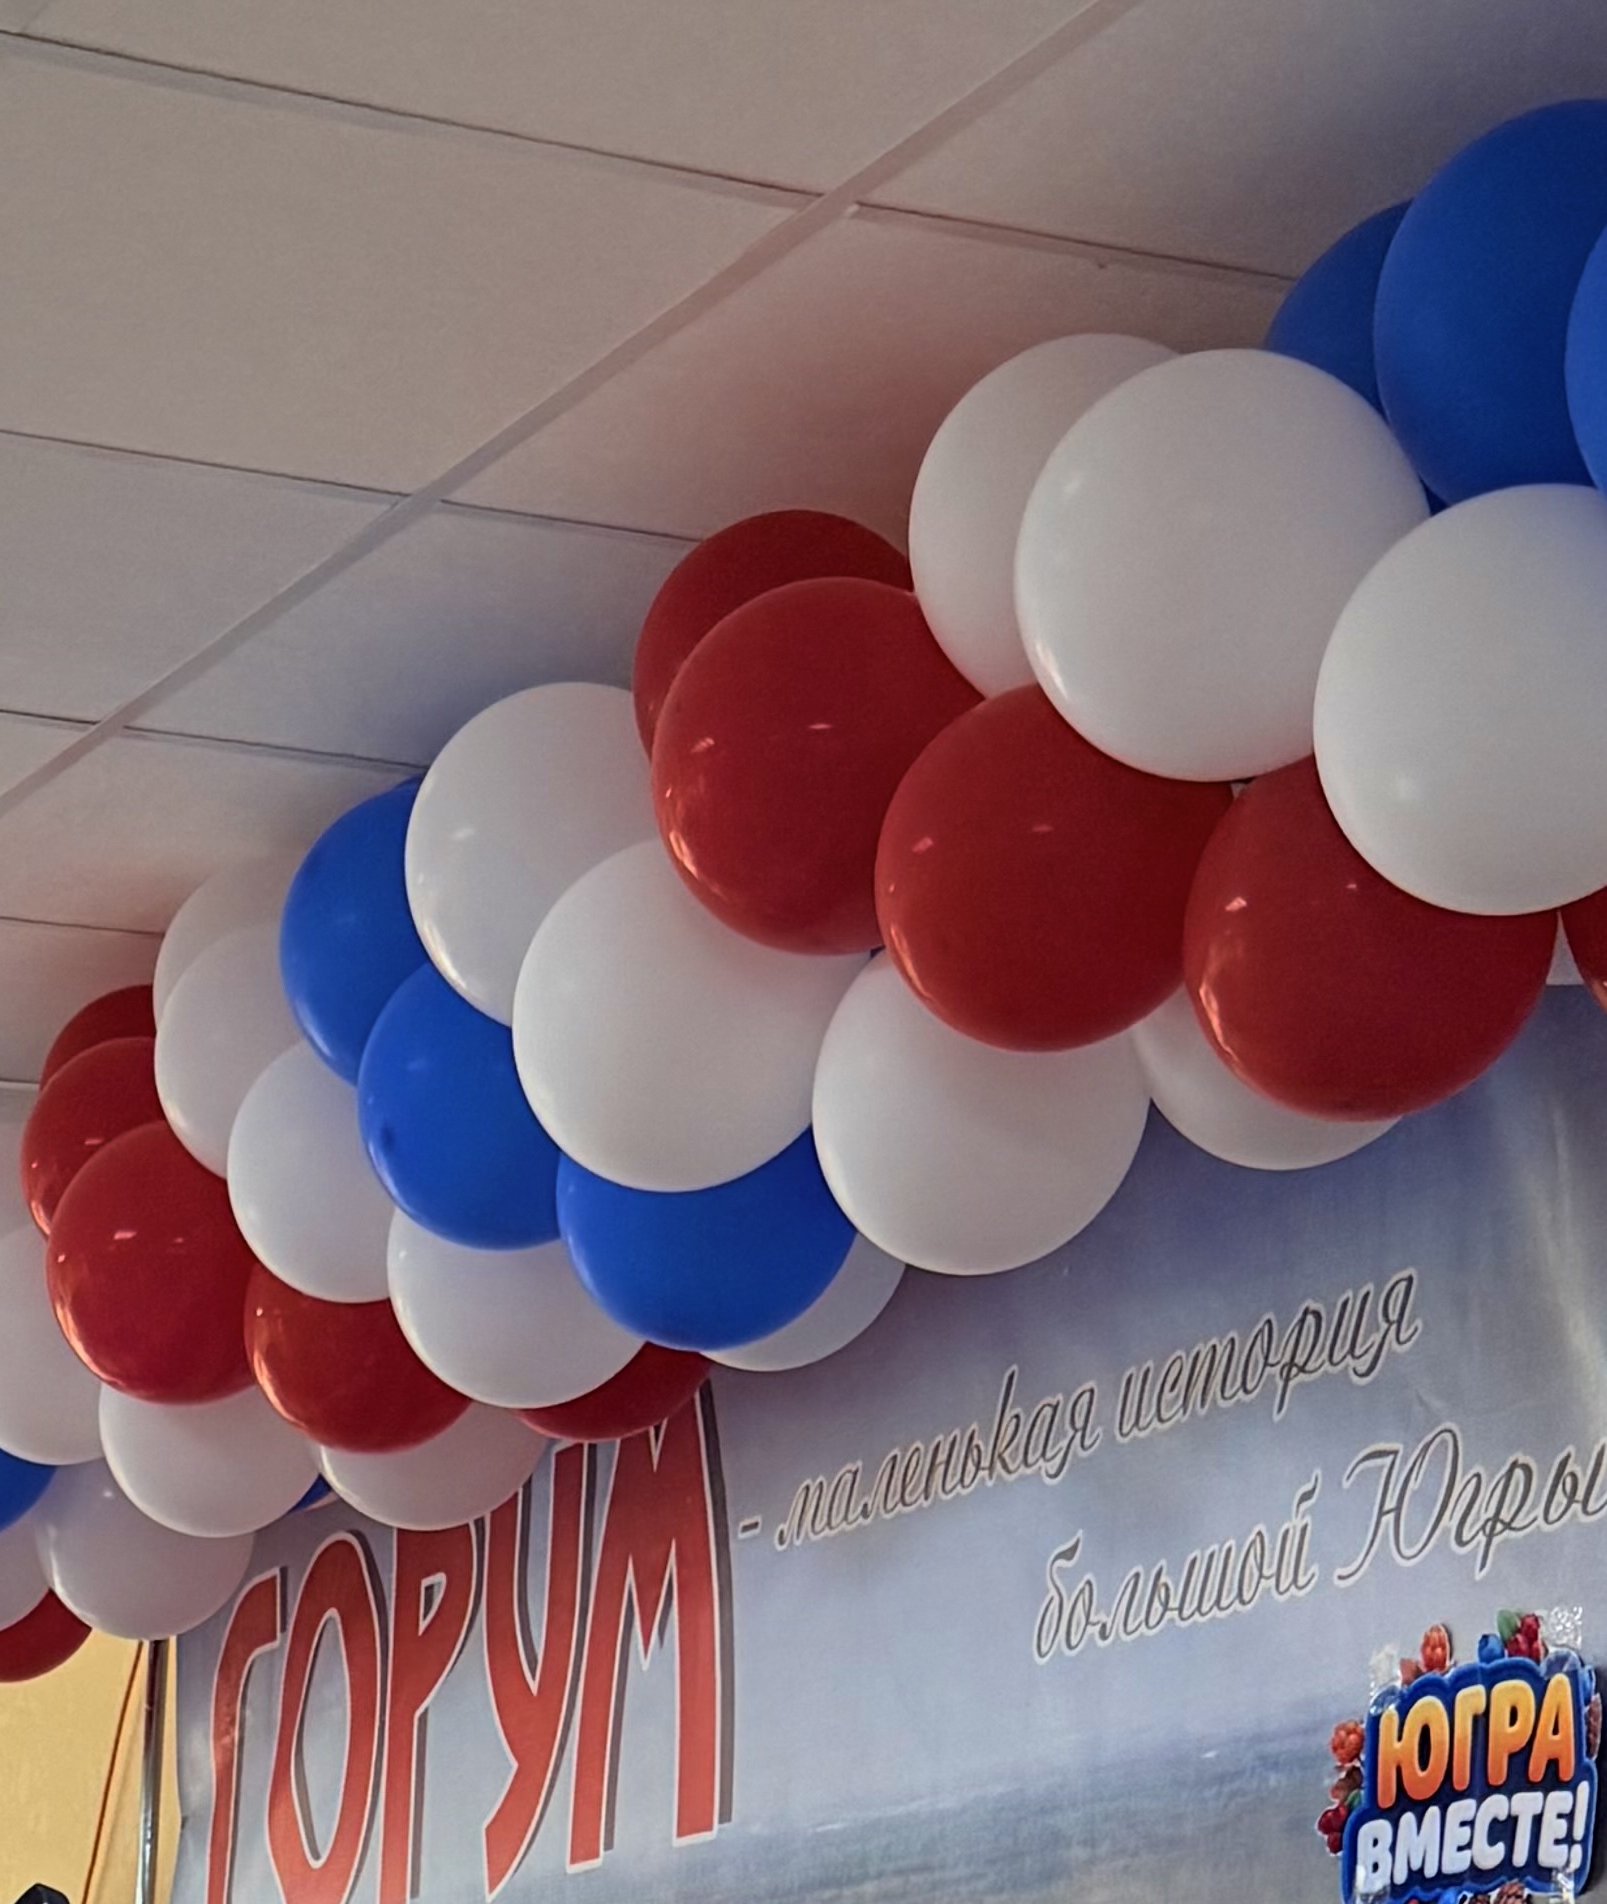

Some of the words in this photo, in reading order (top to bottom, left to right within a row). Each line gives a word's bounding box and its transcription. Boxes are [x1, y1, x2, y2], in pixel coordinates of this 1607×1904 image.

[775, 1365, 1100, 1550] маленькая
[1116, 1266, 1420, 1439] история
[1034, 1468, 1321, 1663] большой
[1334, 1425, 1607, 1577] Югры
[1377, 1673, 1575, 1809] ЮГРА
[1356, 1781, 1590, 1893] ВМЕСТЕ!
